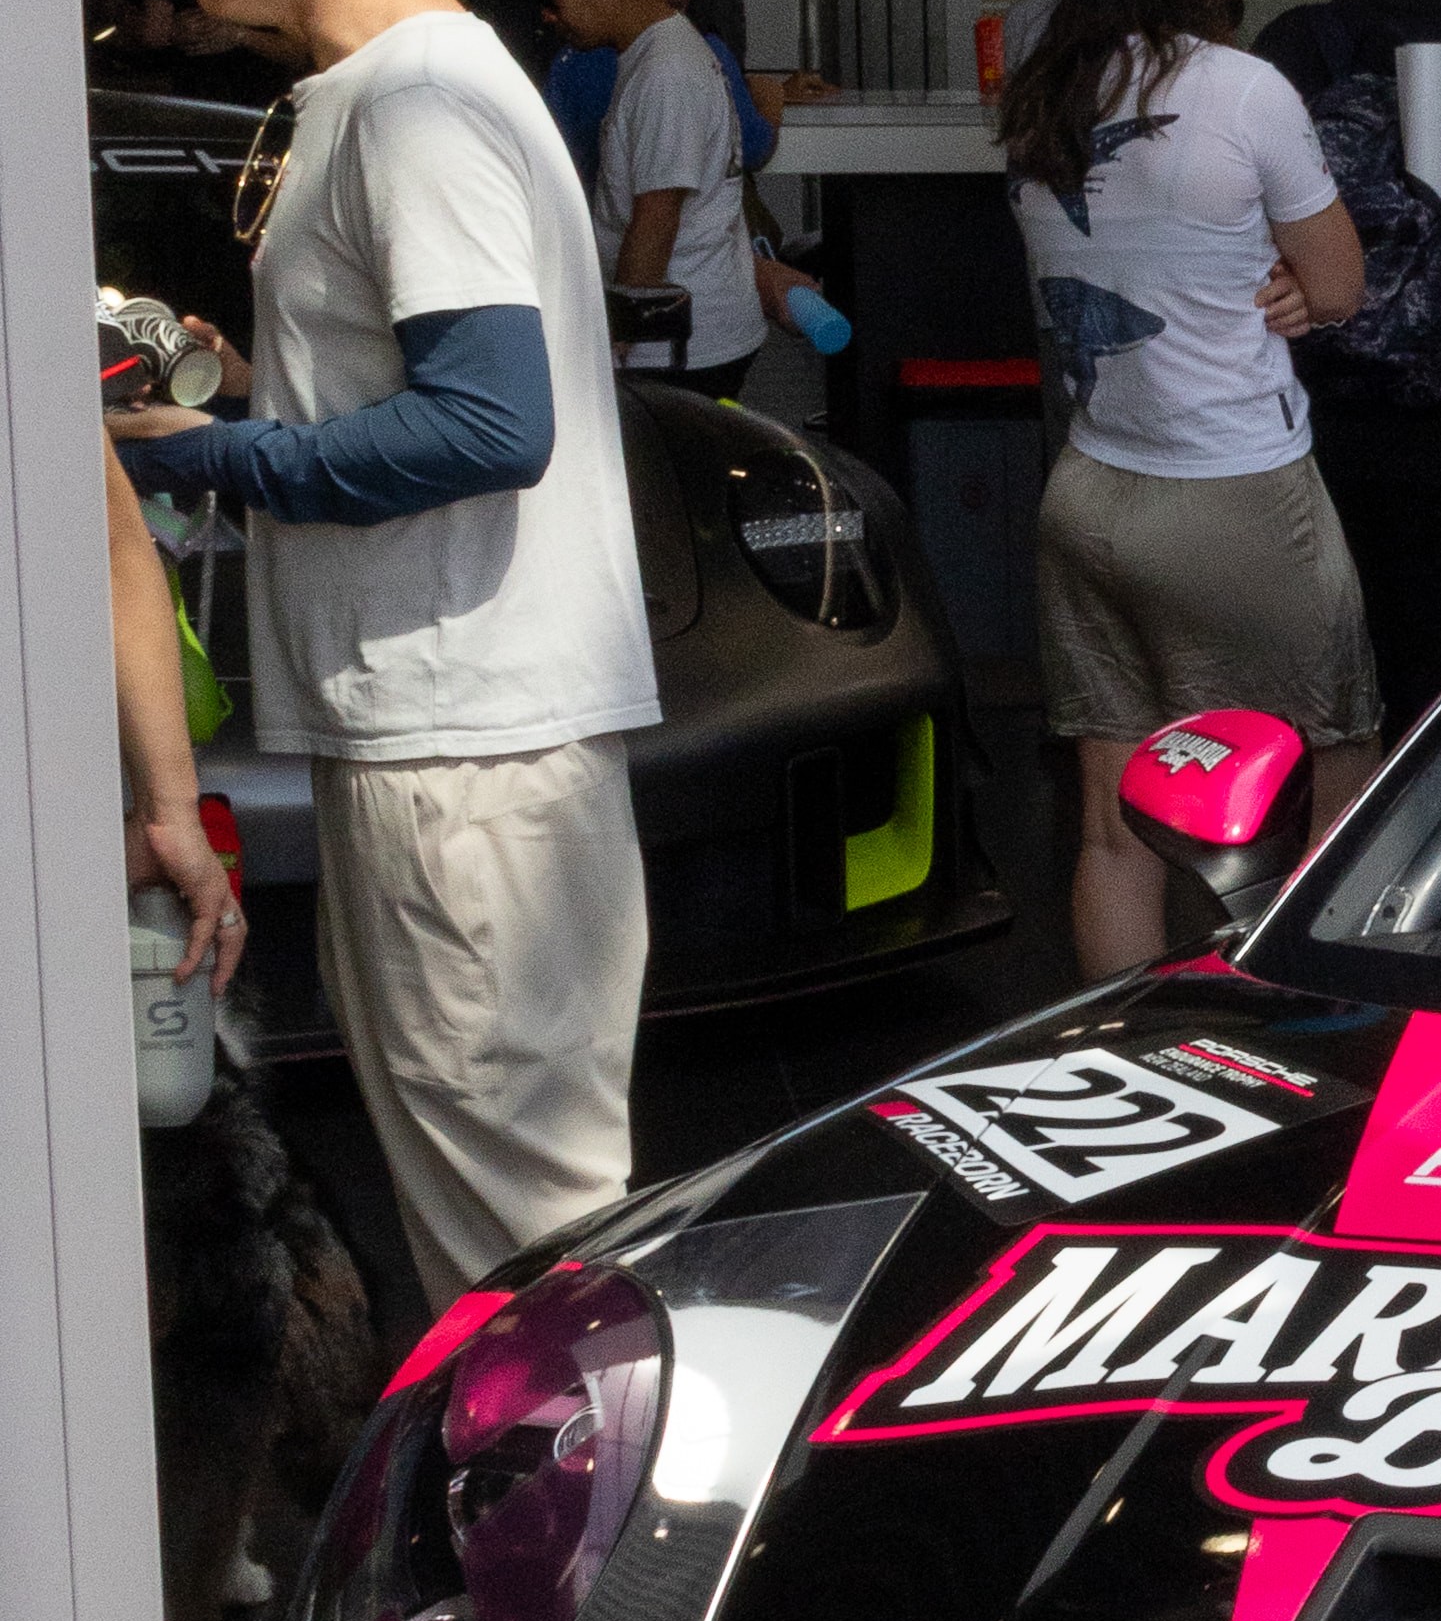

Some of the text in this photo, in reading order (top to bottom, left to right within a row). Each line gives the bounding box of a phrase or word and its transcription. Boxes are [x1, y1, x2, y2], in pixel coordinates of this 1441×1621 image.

[1189, 1037, 1319, 1087] PORSCHE
[889, 1111, 1029, 1202] RACEBORN
[939, 1066, 1226, 1183] 222
